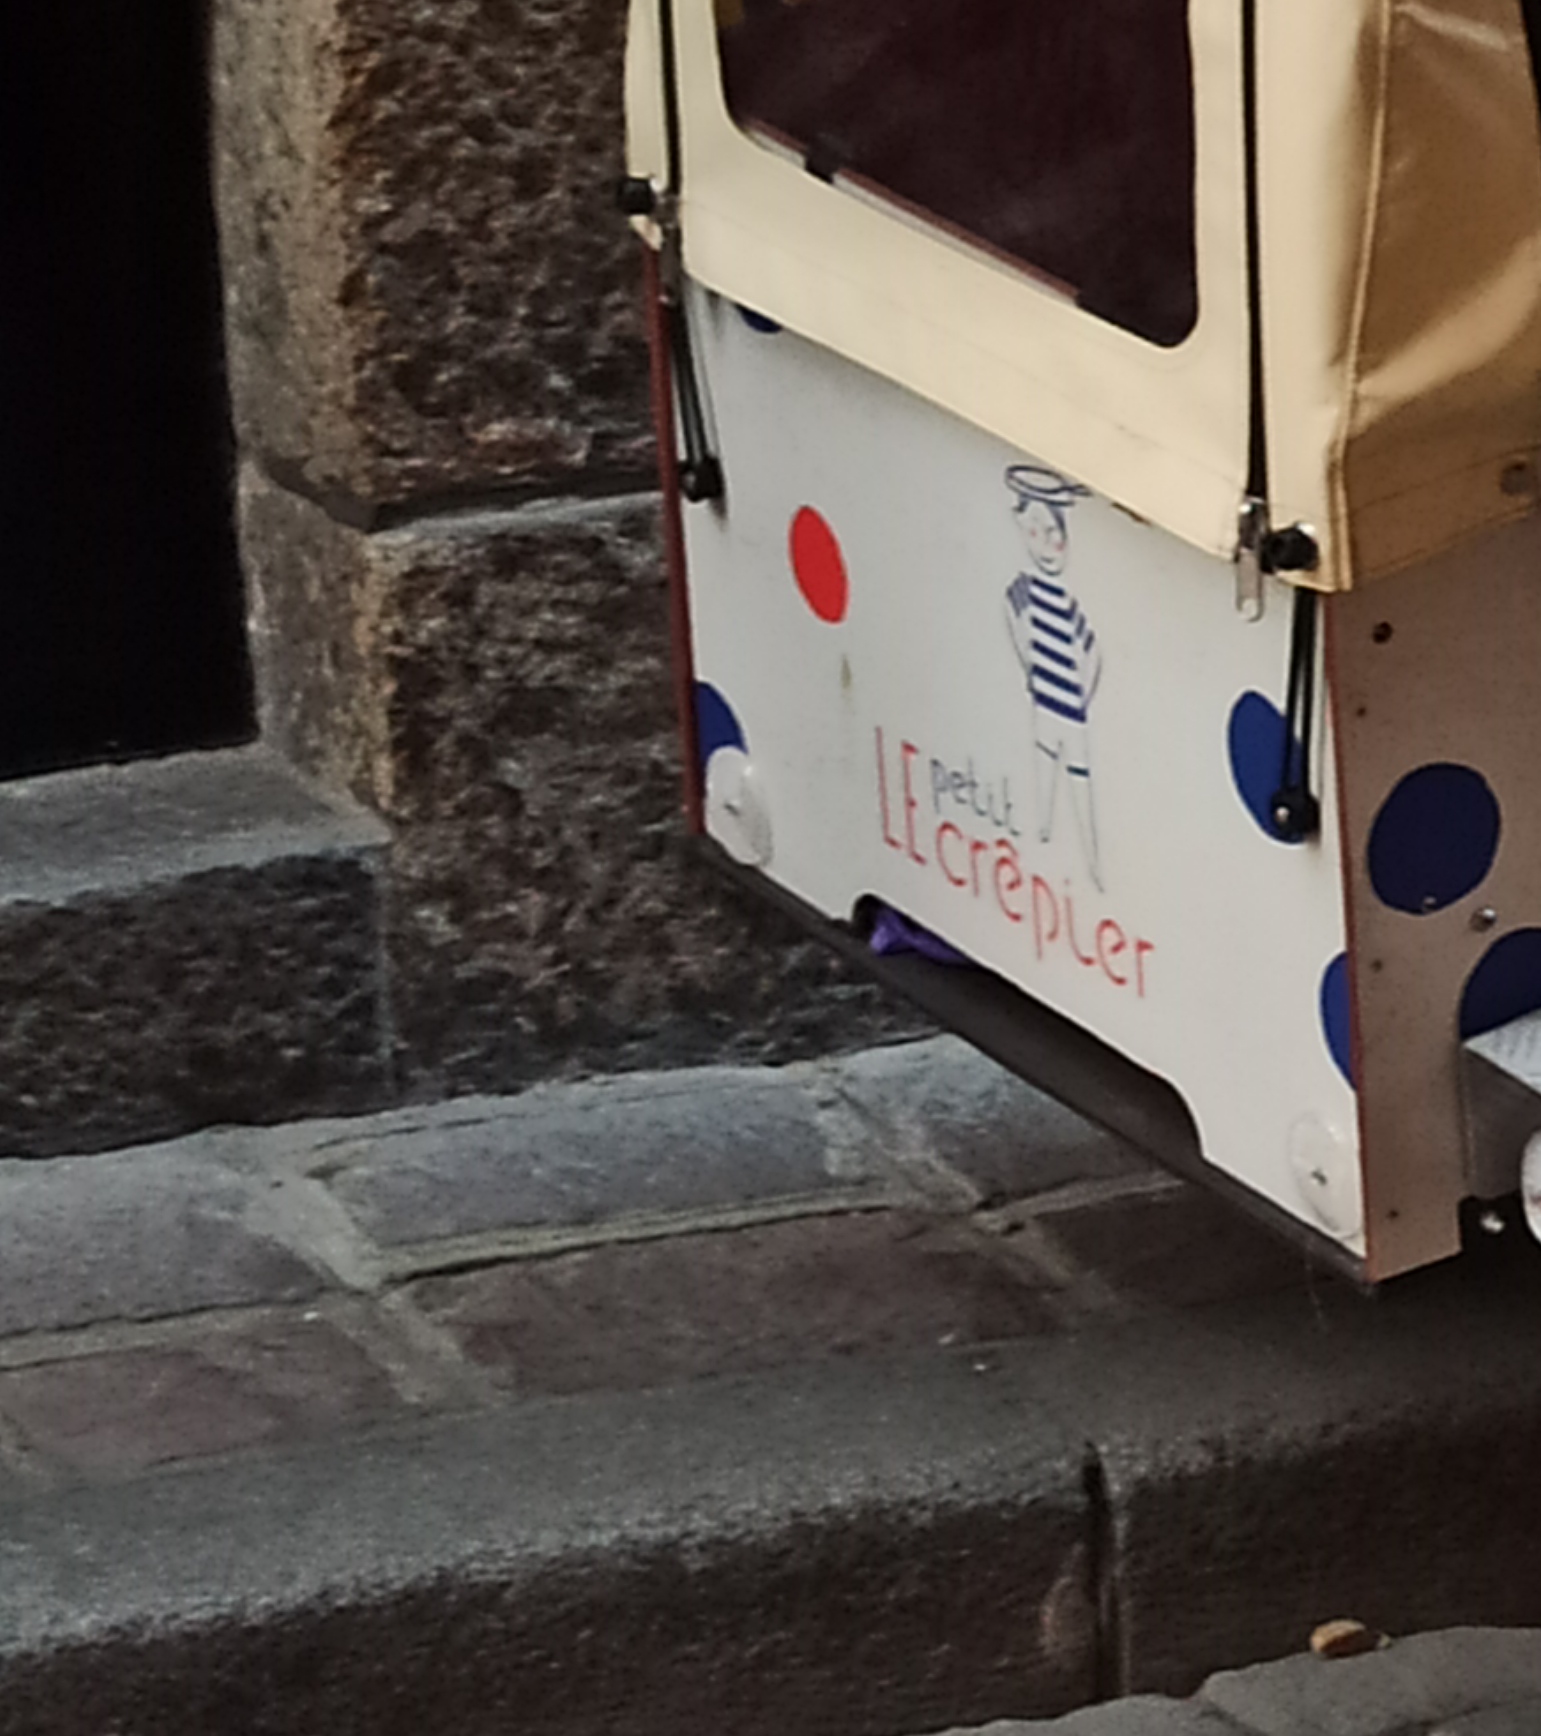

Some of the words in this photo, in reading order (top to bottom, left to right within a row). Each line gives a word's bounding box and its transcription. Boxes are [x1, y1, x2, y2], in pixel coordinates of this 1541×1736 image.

[873, 725, 927, 866] LE
[929, 755, 1021, 838] petit
[934, 819, 1156, 1000] crêpier
